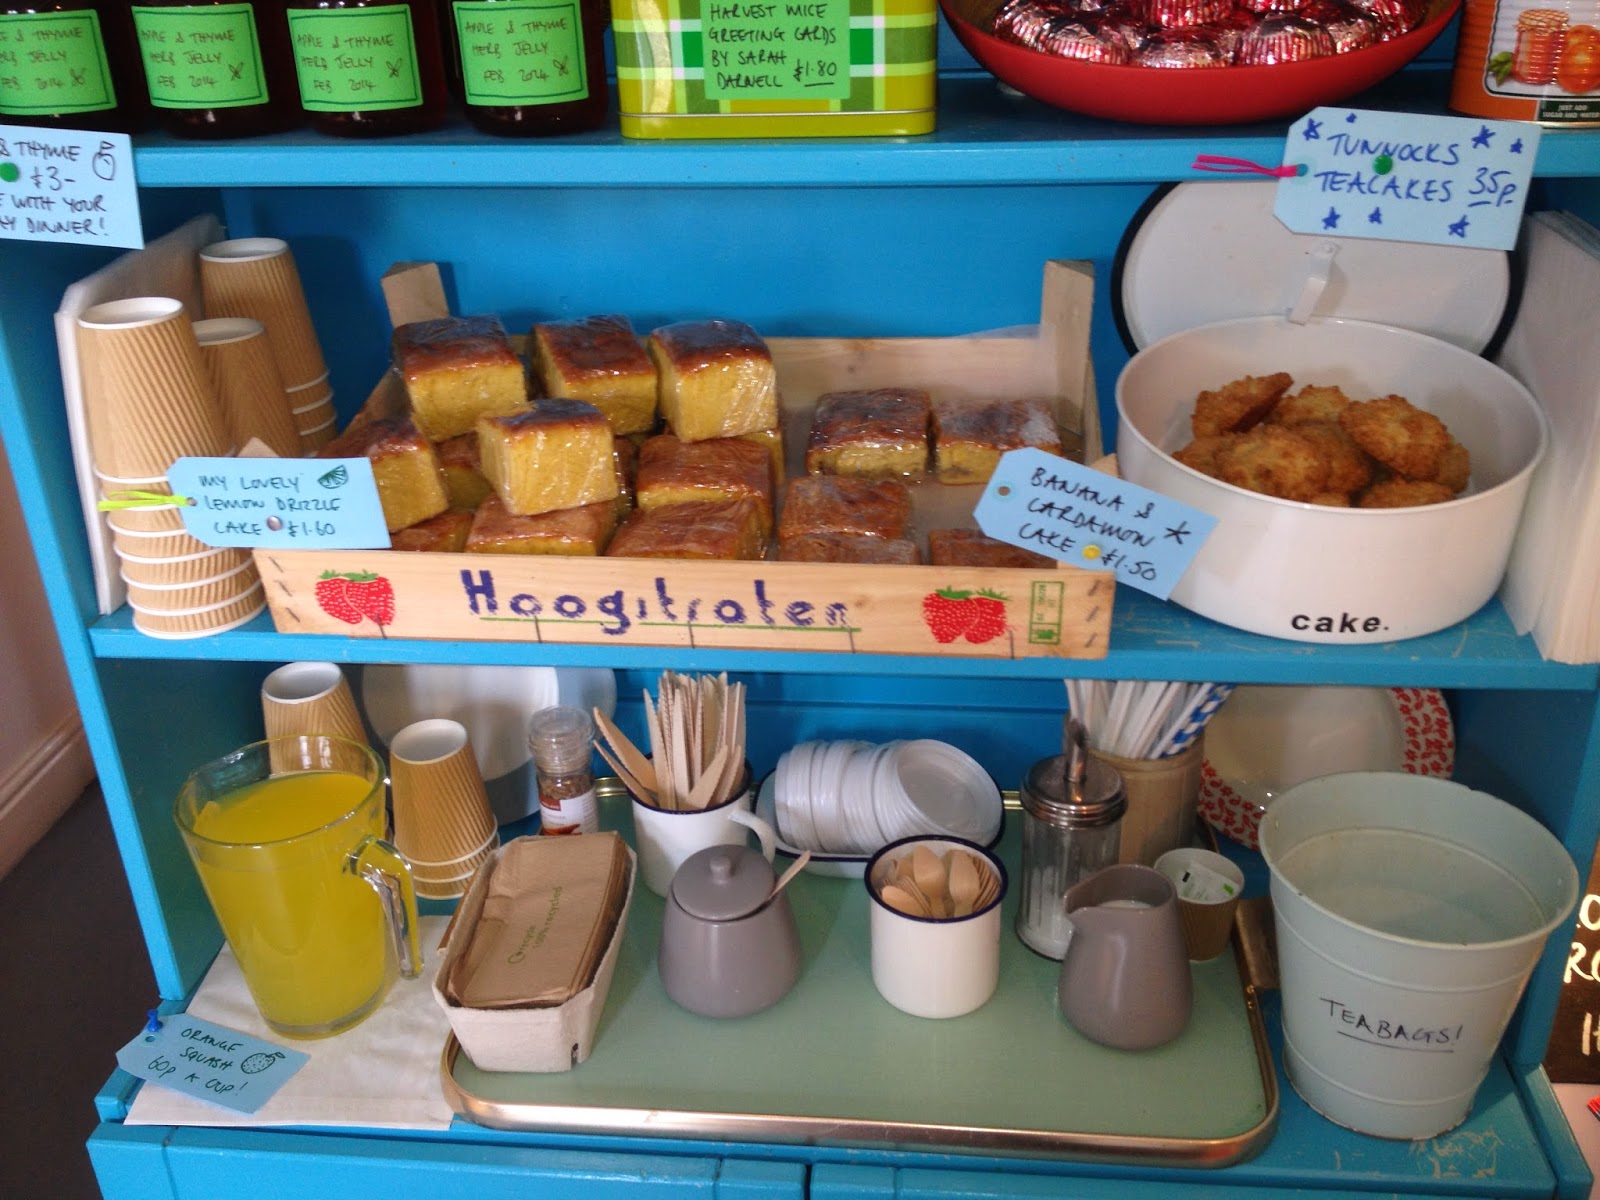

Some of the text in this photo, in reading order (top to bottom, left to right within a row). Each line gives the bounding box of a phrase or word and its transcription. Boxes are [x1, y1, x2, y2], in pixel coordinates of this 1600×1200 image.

[710, 3, 828, 21] HARVEST MICE
[521, 18, 567, 34] THYME
[189, 29, 235, 44] THYME
[345, 34, 395, 48] THYME
[709, 26, 837, 46] GREETING CARDS
[182, 50, 221, 64] JELLY
[512, 41, 548, 56] JELLY
[335, 53, 373, 69] JELLY
[711, 49, 787, 68] BY SARAH
[717, 71, 783, 90] DARNELL
[13, 141, 82, 162] THYME
[1326, 133, 1460, 166] TUNNOCKS
[1314, 166, 1518, 207] TEACAKES 35p
[11, 194, 56, 211] WITH
[62, 194, 107, 213] YOUR
[199, 475, 300, 493] MY LOVELY
[1031, 467, 1155, 519] BANANA &
[203, 495, 341, 511] LEMON DRIZZLE
[213, 521, 262, 536] CAKE
[1019, 523, 1076, 552] CAKE
[1291, 612, 1390, 633] cake.
[1319, 997, 1463, 1045] TEABAGS!
[181, 1028, 244, 1051] ORANGE
[179, 1047, 234, 1070] SQUASH
